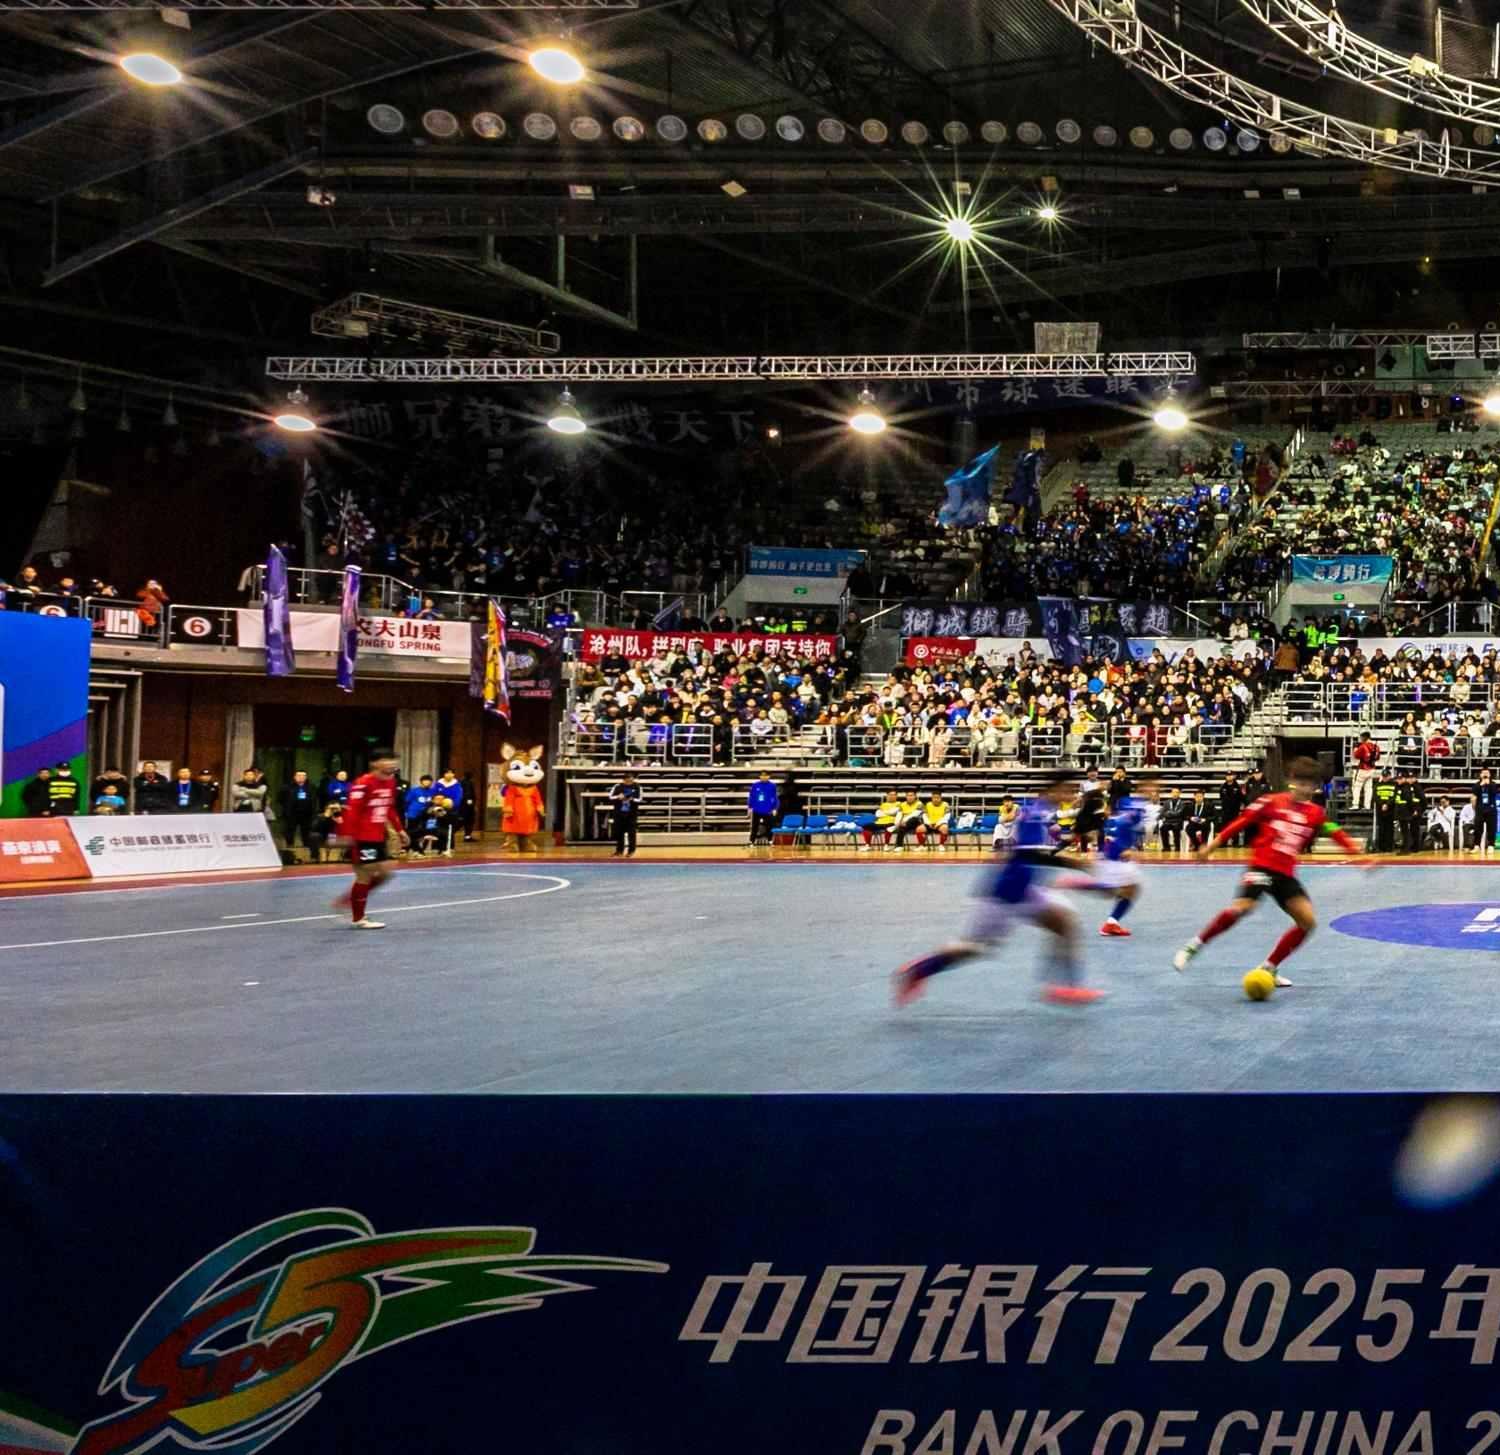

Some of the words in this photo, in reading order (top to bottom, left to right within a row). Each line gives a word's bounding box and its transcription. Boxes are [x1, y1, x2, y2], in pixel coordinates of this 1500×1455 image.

[190, 619, 204, 634] 6
[357, 637, 394, 649] ONGFU
[399, 640, 441, 652] SPRING
[864, 1409, 1084, 1455] BANK
[1094, 1409, 1199, 1455] OF
[1211, 1409, 1434, 1455] CHINA
